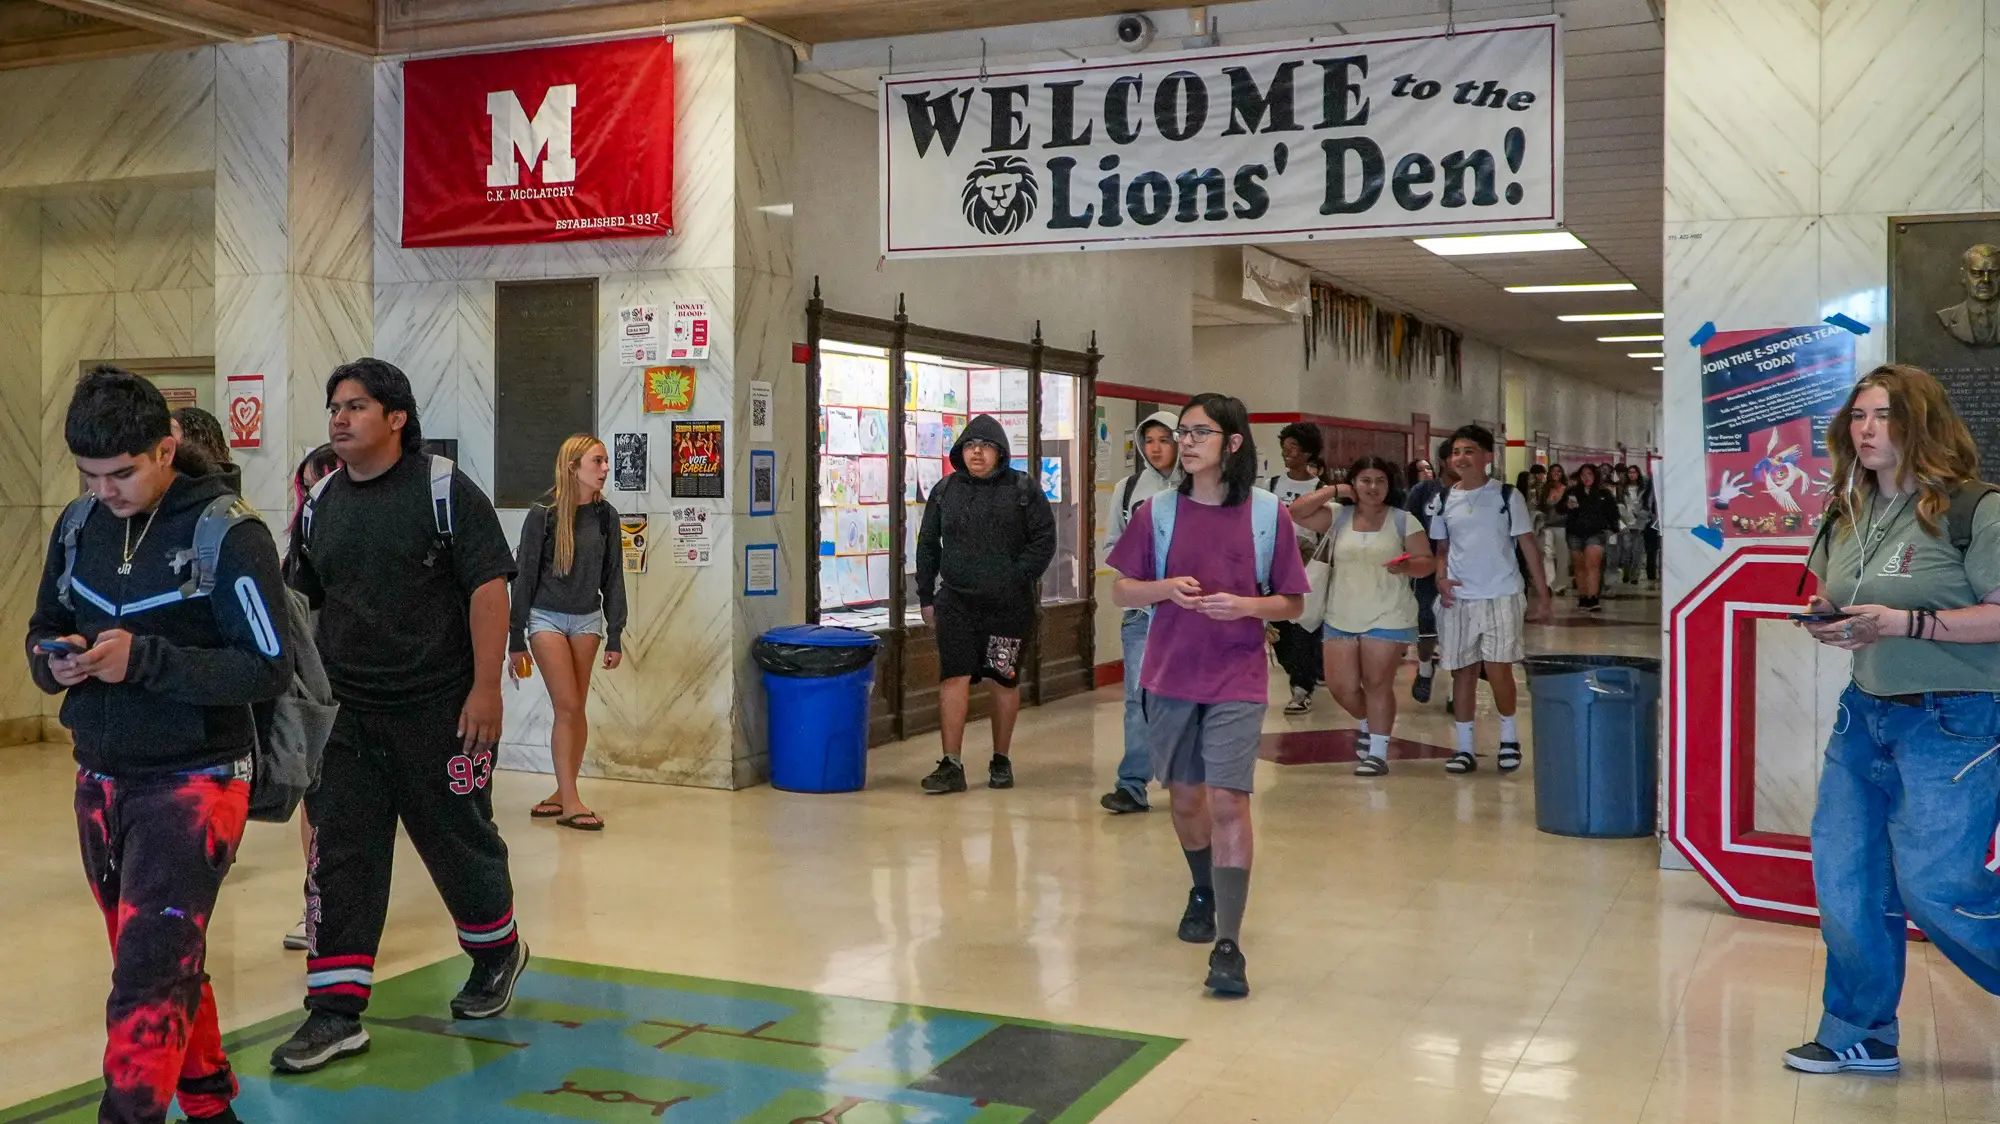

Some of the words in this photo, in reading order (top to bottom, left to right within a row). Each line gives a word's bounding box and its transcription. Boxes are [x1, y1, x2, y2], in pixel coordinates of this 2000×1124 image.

[901, 54, 1370, 159] WELCOME
[1391, 73, 1442, 100] to
[1453, 79, 1537, 113] the
[486, 83, 577, 187] M
[1046, 142, 1289, 230] Lions'
[1320, 126, 1527, 216] Den!
[486, 190, 506, 202] C.K.
[555, 216, 625, 230] ESTABLISHED
[629, 212, 660, 226] 1937
[1702, 358, 1730, 375] JOIN
[1730, 350, 1753, 366] THE
[1754, 334, 1811, 359] E-SPORTS
[1755, 352, 1796, 373] TODAY
[680, 462, 719, 474] ISABELLA
[689, 455, 707, 464] VOTE
[447, 749, 493, 795] 93
